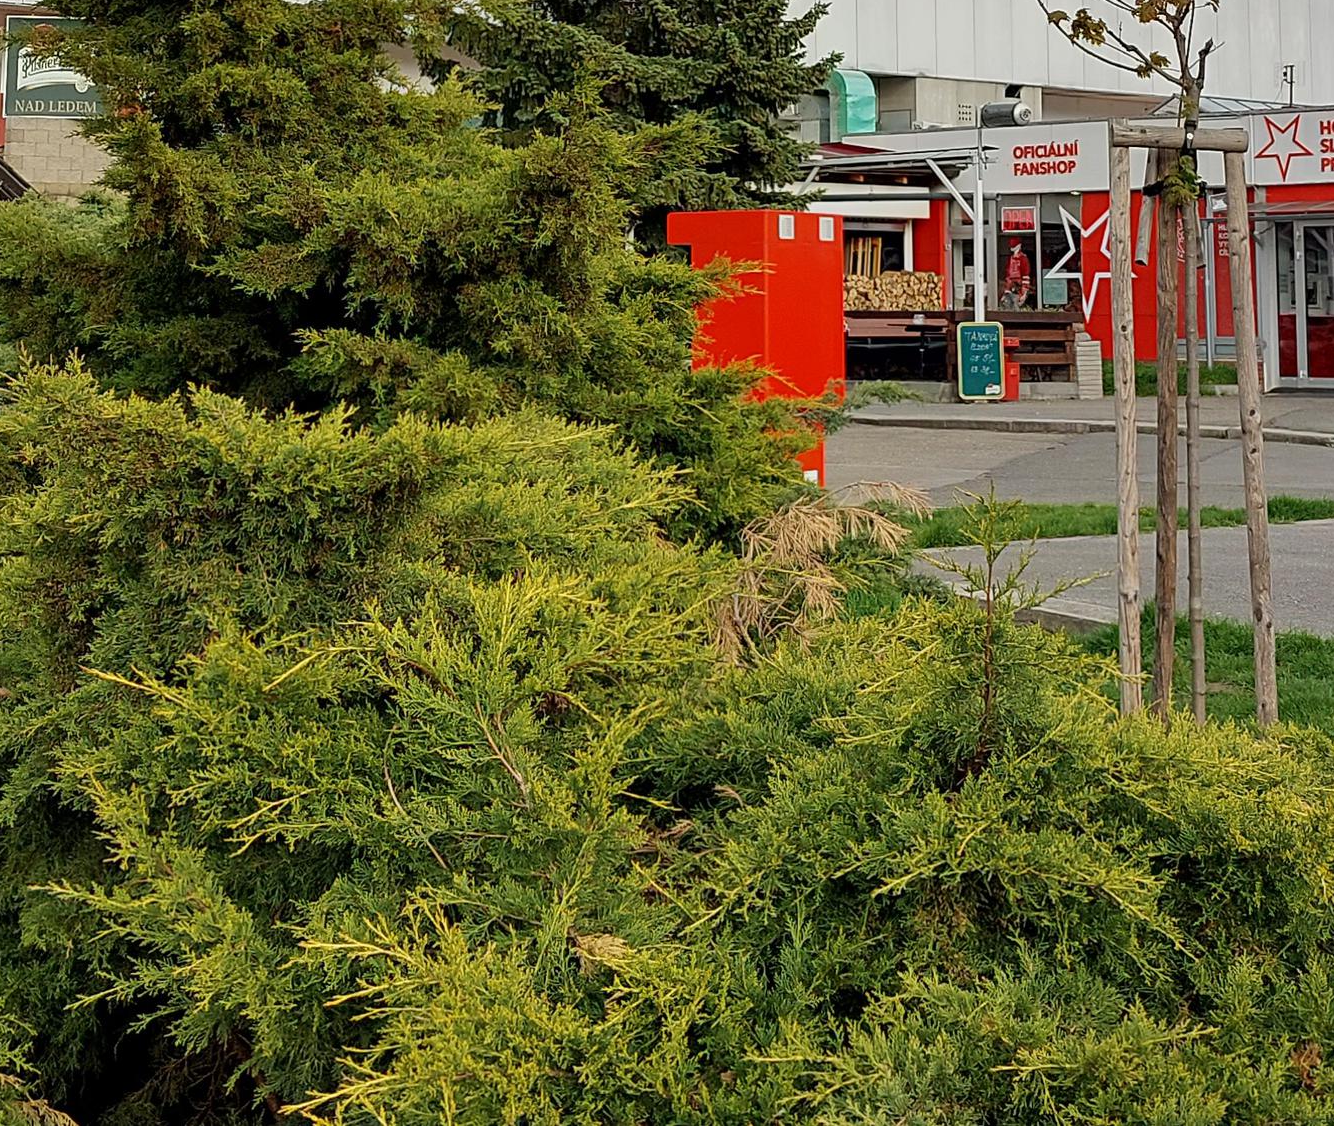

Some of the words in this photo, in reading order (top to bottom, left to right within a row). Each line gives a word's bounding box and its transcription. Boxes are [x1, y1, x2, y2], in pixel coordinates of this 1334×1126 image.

[15, 99, 44, 113] NAD
[48, 100, 97, 114] LEDEM
[1013, 139, 1079, 159] OFICIÁLNÍ
[1013, 161, 1076, 176] FANSHOP
